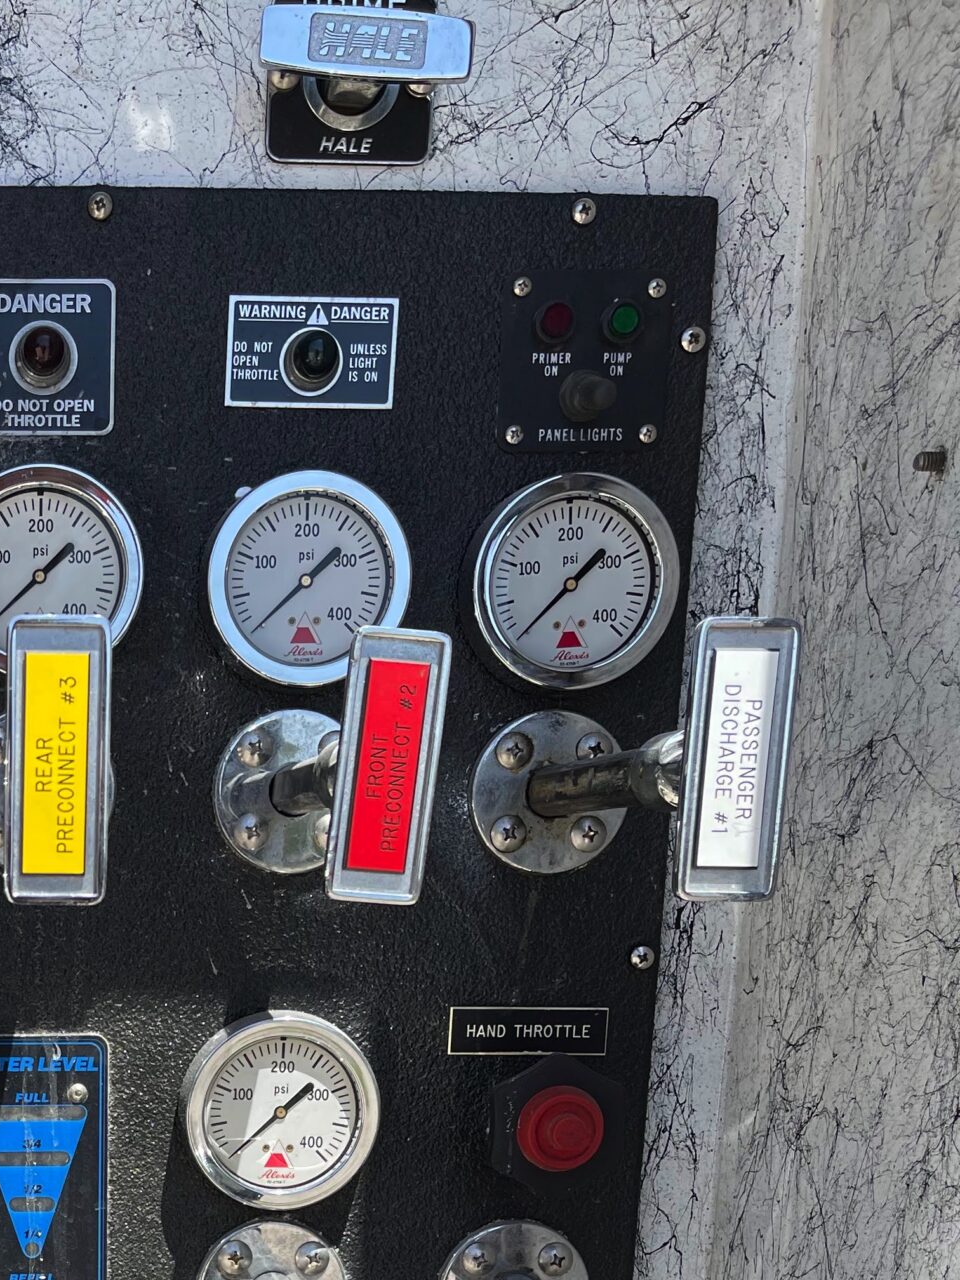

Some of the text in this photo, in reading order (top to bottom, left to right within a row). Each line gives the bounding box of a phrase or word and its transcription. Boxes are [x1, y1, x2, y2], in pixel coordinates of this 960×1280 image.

[319, 22, 418, 62] HALE
[319, 136, 373, 154] HALE
[238, 304, 390, 320] WARNING DANGER
[234, 341, 273, 353] DO NOT
[350, 344, 388, 356] UNLESS
[233, 355, 259, 366] OPEN
[349, 358, 378, 369] LIGHT
[532, 352, 572, 364] PRIMER
[603, 352, 632, 364] PUMP
[232, 369, 279, 381] THROTTLE
[348, 371, 378, 382] IS ON
[544, 366, 558, 376] ON
[610, 365, 624, 376] ON
[18, 400, 49, 412] NOT
[54, 400, 94, 412] OPEN
[8, 414, 80, 427] THROTTLE
[538, 428, 623, 442] PANEL LIGHTS
[28, 518, 54, 533] 200
[294, 523, 320, 538] 200
[558, 526, 584, 542] 200
[32, 544, 49, 558] psi
[68, 550, 92, 564] 300
[298, 548, 314, 563] psi
[255, 554, 277, 568] 100
[334, 554, 357, 568] 300
[562, 552, 578, 567] psi
[598, 554, 621, 570] 300
[518, 560, 540, 576] 100
[62, 603, 87, 614] 400
[327, 606, 352, 621] 400
[592, 608, 618, 623] 400
[35, 736, 53, 792] REAR
[56, 676, 78, 854] PRECONNECT #3
[711, 684, 742, 834] DISCHARGE #1
[734, 699, 763, 820] PASSENGER
[366, 734, 390, 800] FRONT
[380, 684, 416, 852] PRECONNECT #2
[466, 1024, 592, 1038] HAND THROTTLE
[37, 1056, 98, 1072] LEVEL
[270, 1060, 295, 1074] 200
[16, 1092, 49, 1103] FULL
[232, 1088, 254, 1101] 100
[274, 1085, 289, 1096] psi
[307, 1088, 329, 1101] 300
[300, 1136, 323, 1148] 400
